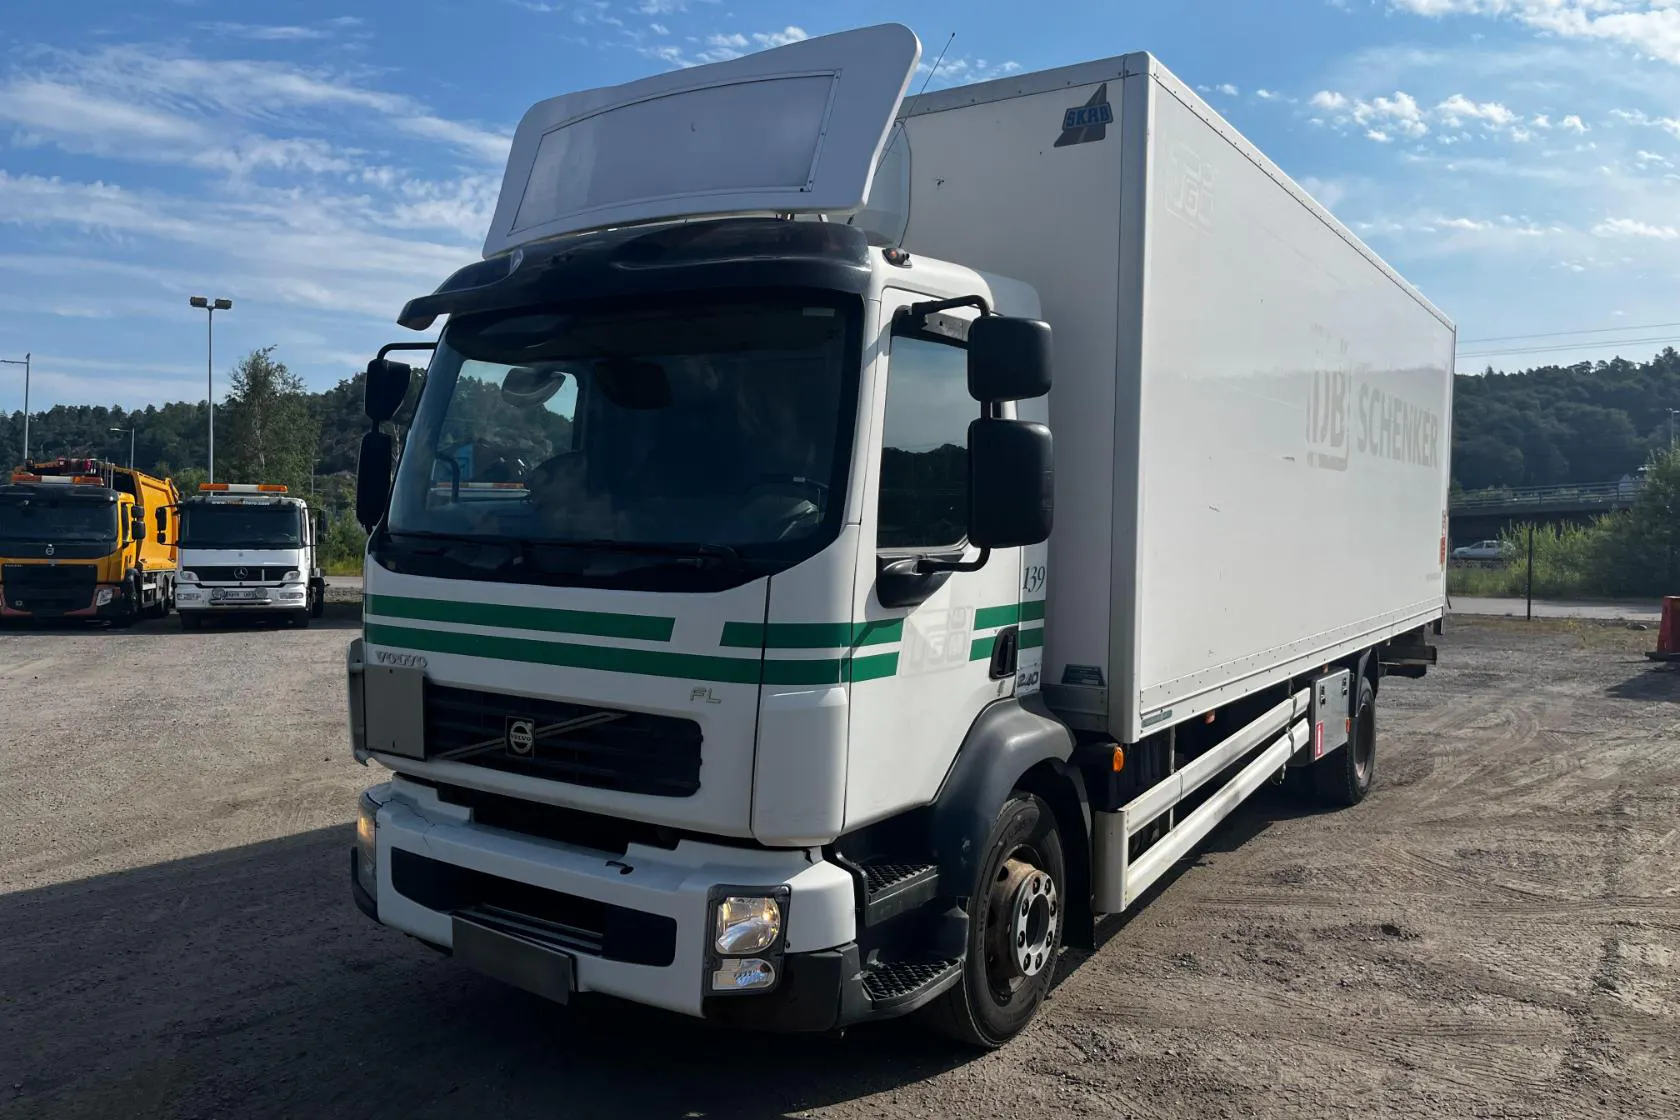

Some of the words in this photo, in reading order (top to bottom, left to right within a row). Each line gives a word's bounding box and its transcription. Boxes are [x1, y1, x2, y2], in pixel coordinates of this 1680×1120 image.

[1357, 381, 1439, 470] SCHENKER
[1022, 566, 1046, 593] 139
[375, 650, 429, 668] VOLVO
[690, 687, 722, 704] FL
